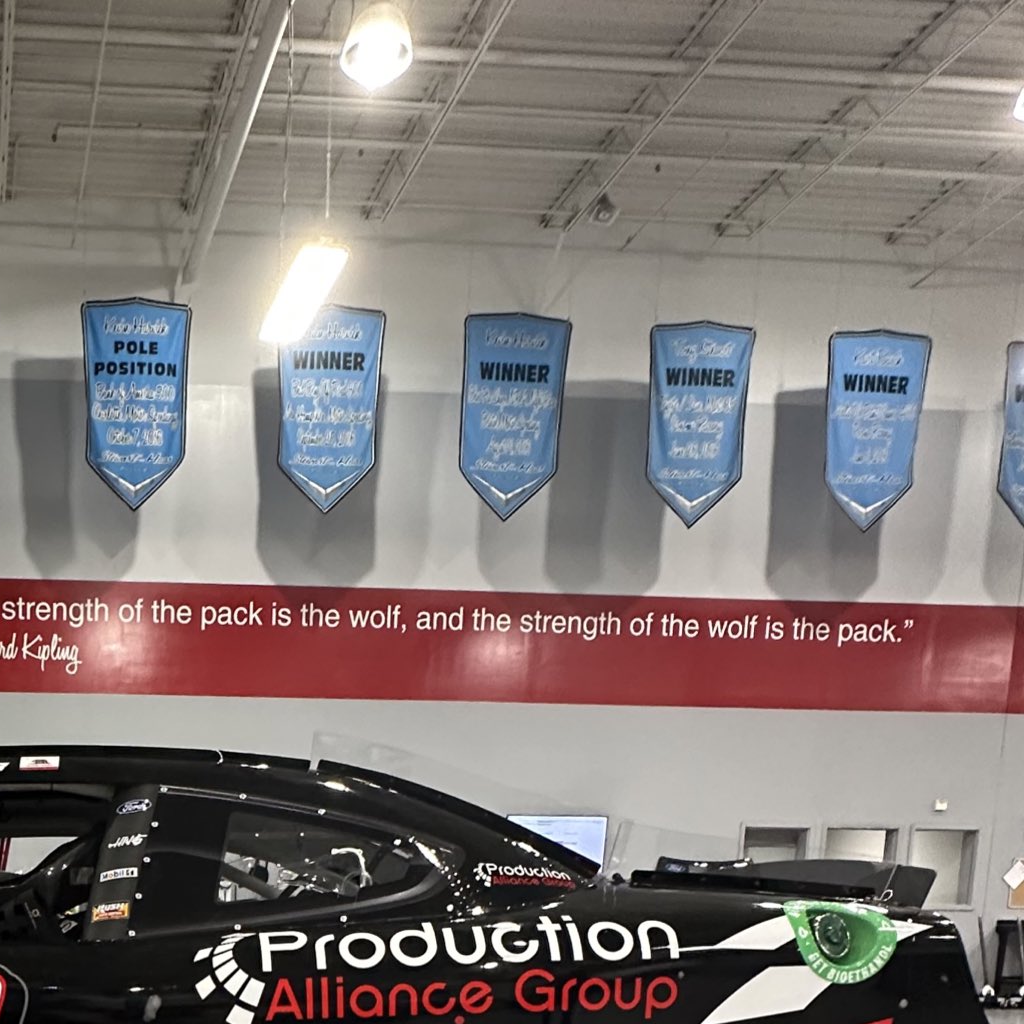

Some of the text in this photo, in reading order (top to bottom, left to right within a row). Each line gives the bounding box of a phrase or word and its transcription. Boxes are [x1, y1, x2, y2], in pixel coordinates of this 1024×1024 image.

[114, 341, 158, 354] POLE
[94, 362, 177, 377] POSITION
[293, 350, 365, 371] WINNER
[480, 361, 550, 383] WINNER
[666, 368, 735, 388] WINNER
[843, 373, 909, 395] WINNER
[1, 597, 109, 628] strength
[118, 598, 144, 623] of
[151, 598, 192, 624] the
[200, 601, 263, 631] pack
[271, 602, 292, 627] is
[300, 603, 341, 628] the
[349, 604, 407, 633] wolf,
[416, 606, 464, 631] and
[472, 607, 511, 632] the
[519, 610, 621, 641] strength
[629, 612, 654, 637] of
[661, 613, 699, 638] the
[708, 615, 758, 640] wolf
[764, 616, 784, 641] is
[792, 617, 830, 641] the
[21, 632, 83, 675] Kipling
[121, 801, 148, 813] Ford
[486, 863, 572, 881] Production
[492, 876, 540, 887] Alliance
[258, 915, 680, 972] Production
[265, 968, 678, 1021] Alliance Group
